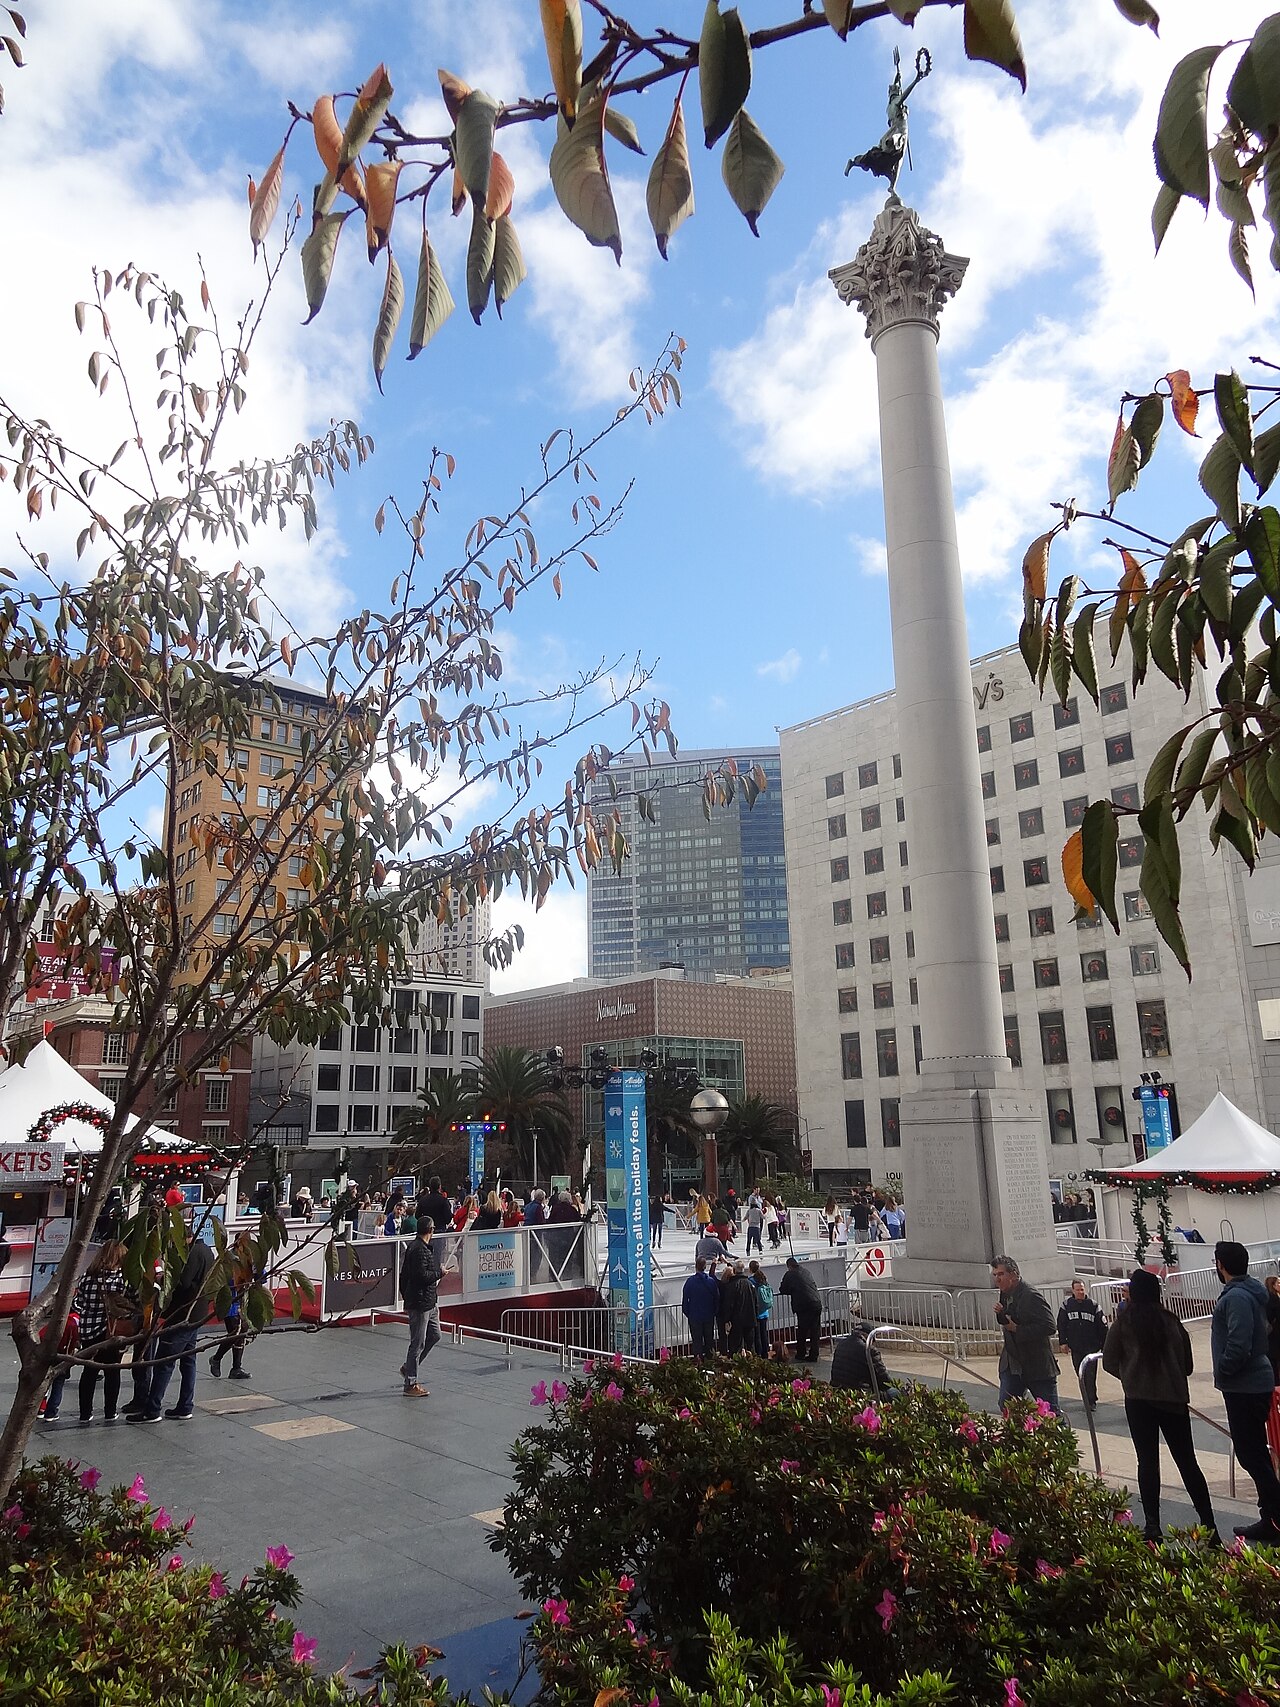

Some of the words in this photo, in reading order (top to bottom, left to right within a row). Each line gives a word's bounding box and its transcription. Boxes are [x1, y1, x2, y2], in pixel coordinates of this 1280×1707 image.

[615, 996, 637, 1021] Marcus
[629, 1105, 639, 1144] feels.
[630, 1145, 642, 1196] holiday
[632, 1198, 642, 1222] the
[632, 1224, 643, 1240] all
[479, 1250, 515, 1263] HOLIDAY
[635, 1242, 644, 1258] to
[333, 1267, 388, 1282] RESNATE
[479, 1261, 493, 1272] ICE
[495, 1260, 514, 1271] RINK
[635, 1260, 645, 1321] Nonstop
